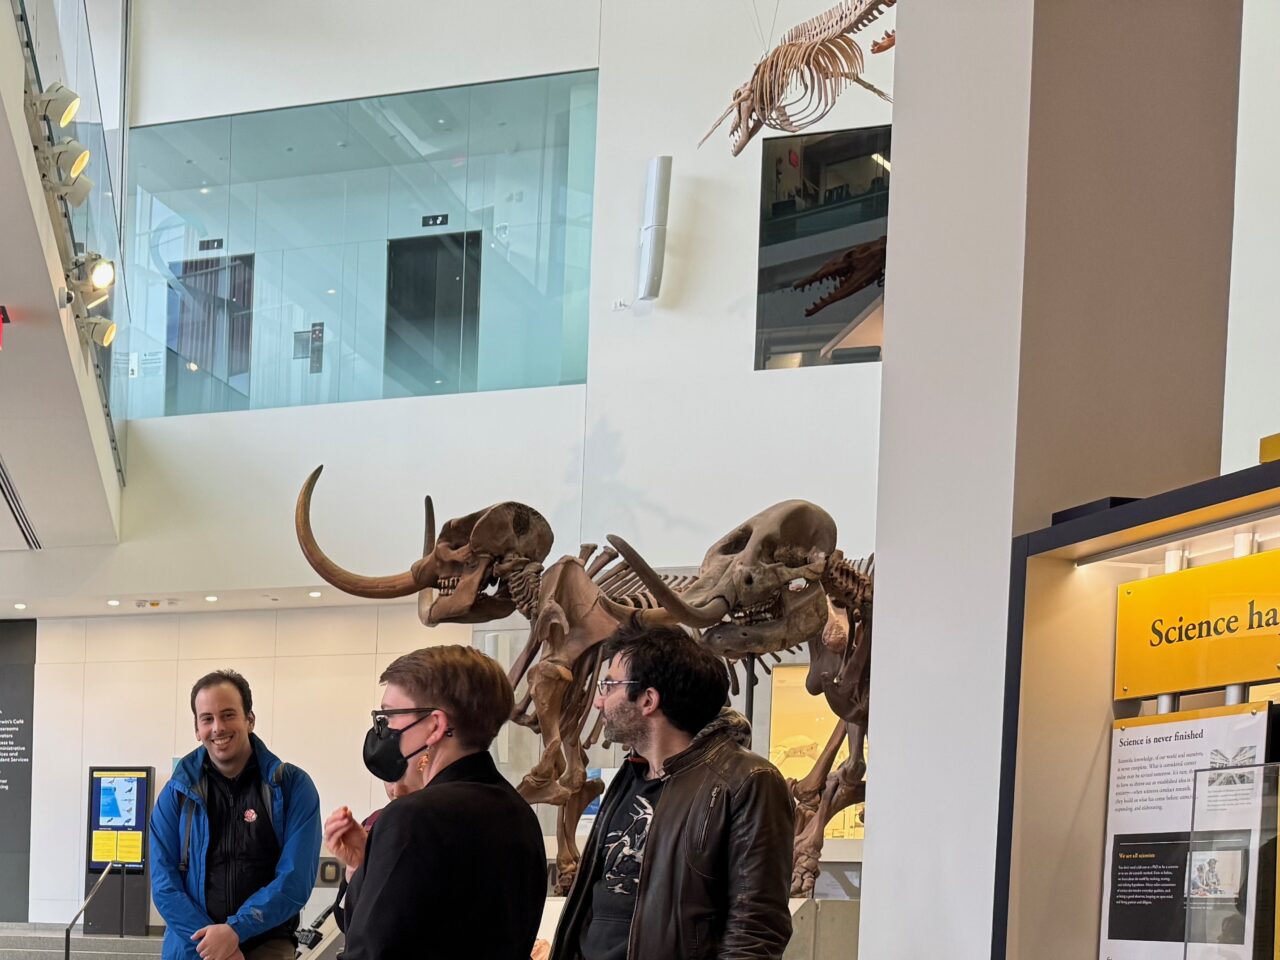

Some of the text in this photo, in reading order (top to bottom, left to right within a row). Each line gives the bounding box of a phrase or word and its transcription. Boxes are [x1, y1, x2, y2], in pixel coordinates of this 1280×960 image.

[1150, 600, 1280, 647] Science ha
[1119, 729, 1204, 748] Science is never finished
